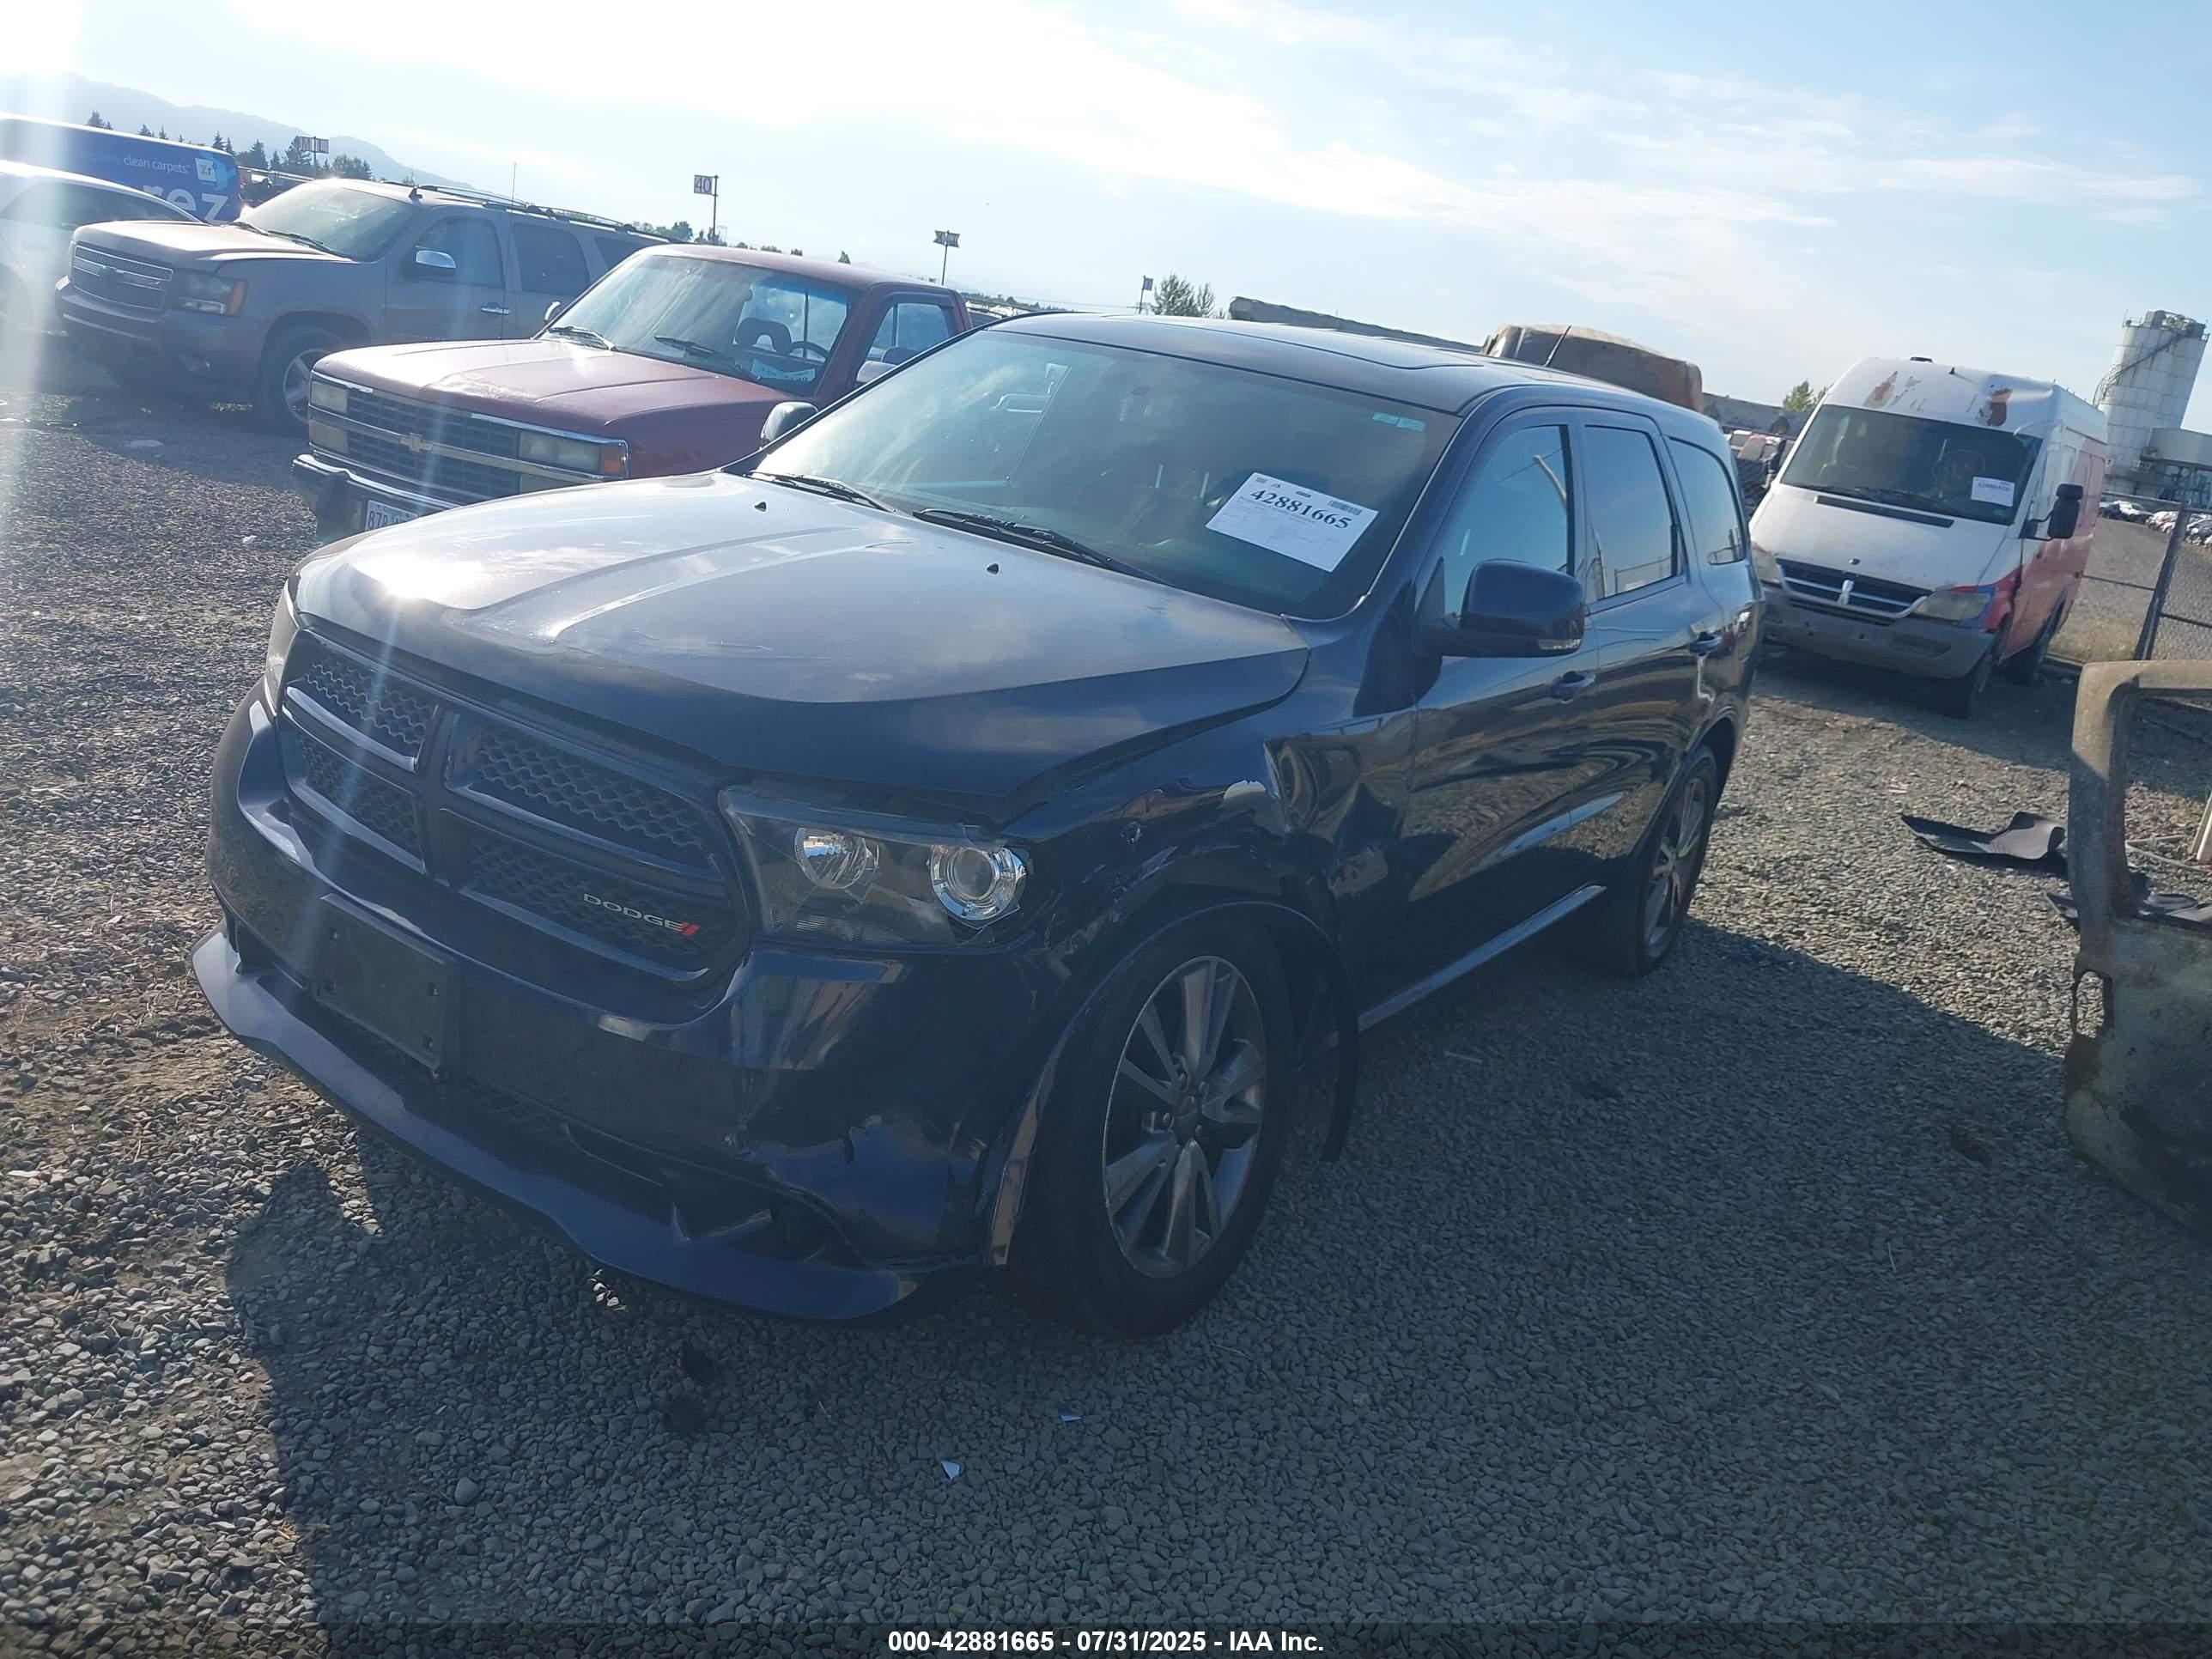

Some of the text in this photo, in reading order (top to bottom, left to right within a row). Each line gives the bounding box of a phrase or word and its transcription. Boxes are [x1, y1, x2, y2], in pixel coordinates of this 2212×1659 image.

[124, 154, 151, 169] clean
[695, 176, 711, 193] 40
[1250, 490, 1352, 528] 42881665
[583, 893, 686, 933] DODGE
